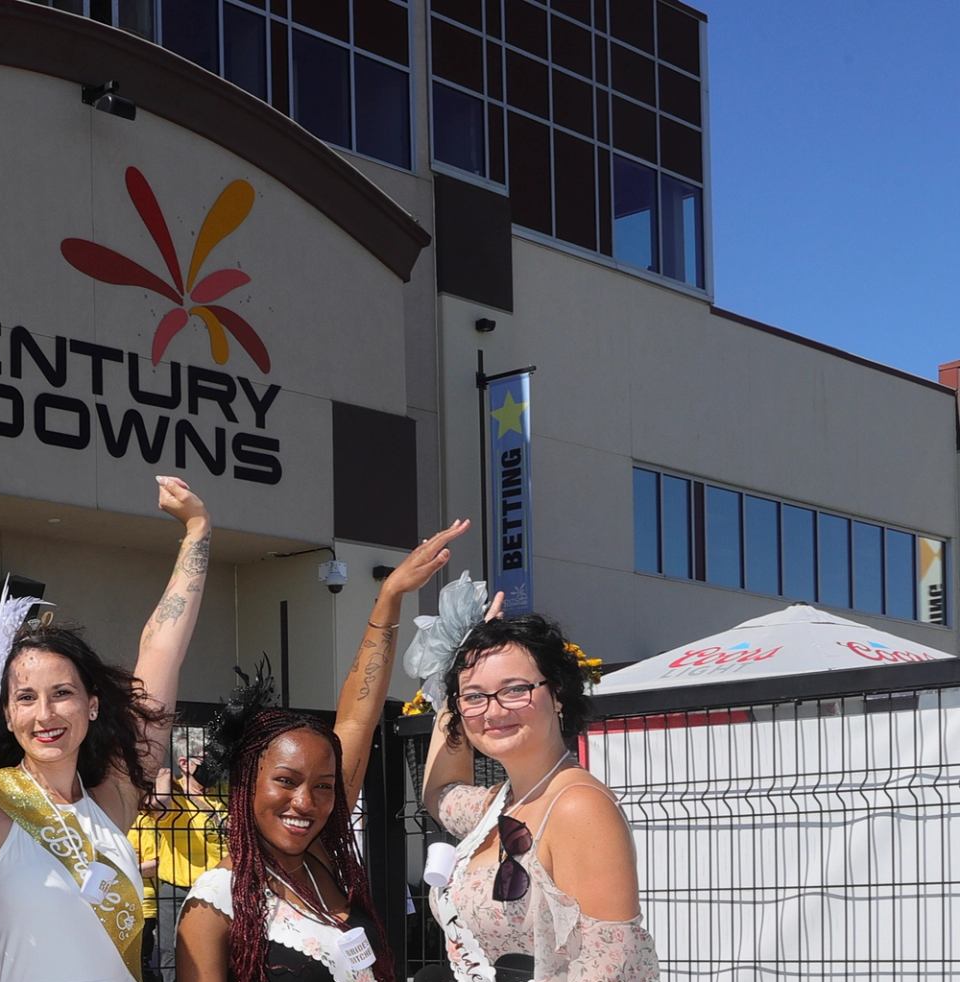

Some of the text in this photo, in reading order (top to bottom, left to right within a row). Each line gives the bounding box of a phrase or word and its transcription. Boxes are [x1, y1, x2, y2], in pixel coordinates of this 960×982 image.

[502, 448, 522, 571] BETTING
[668, 646, 784, 668] Coors
[659, 661, 754, 679] LIGHT
